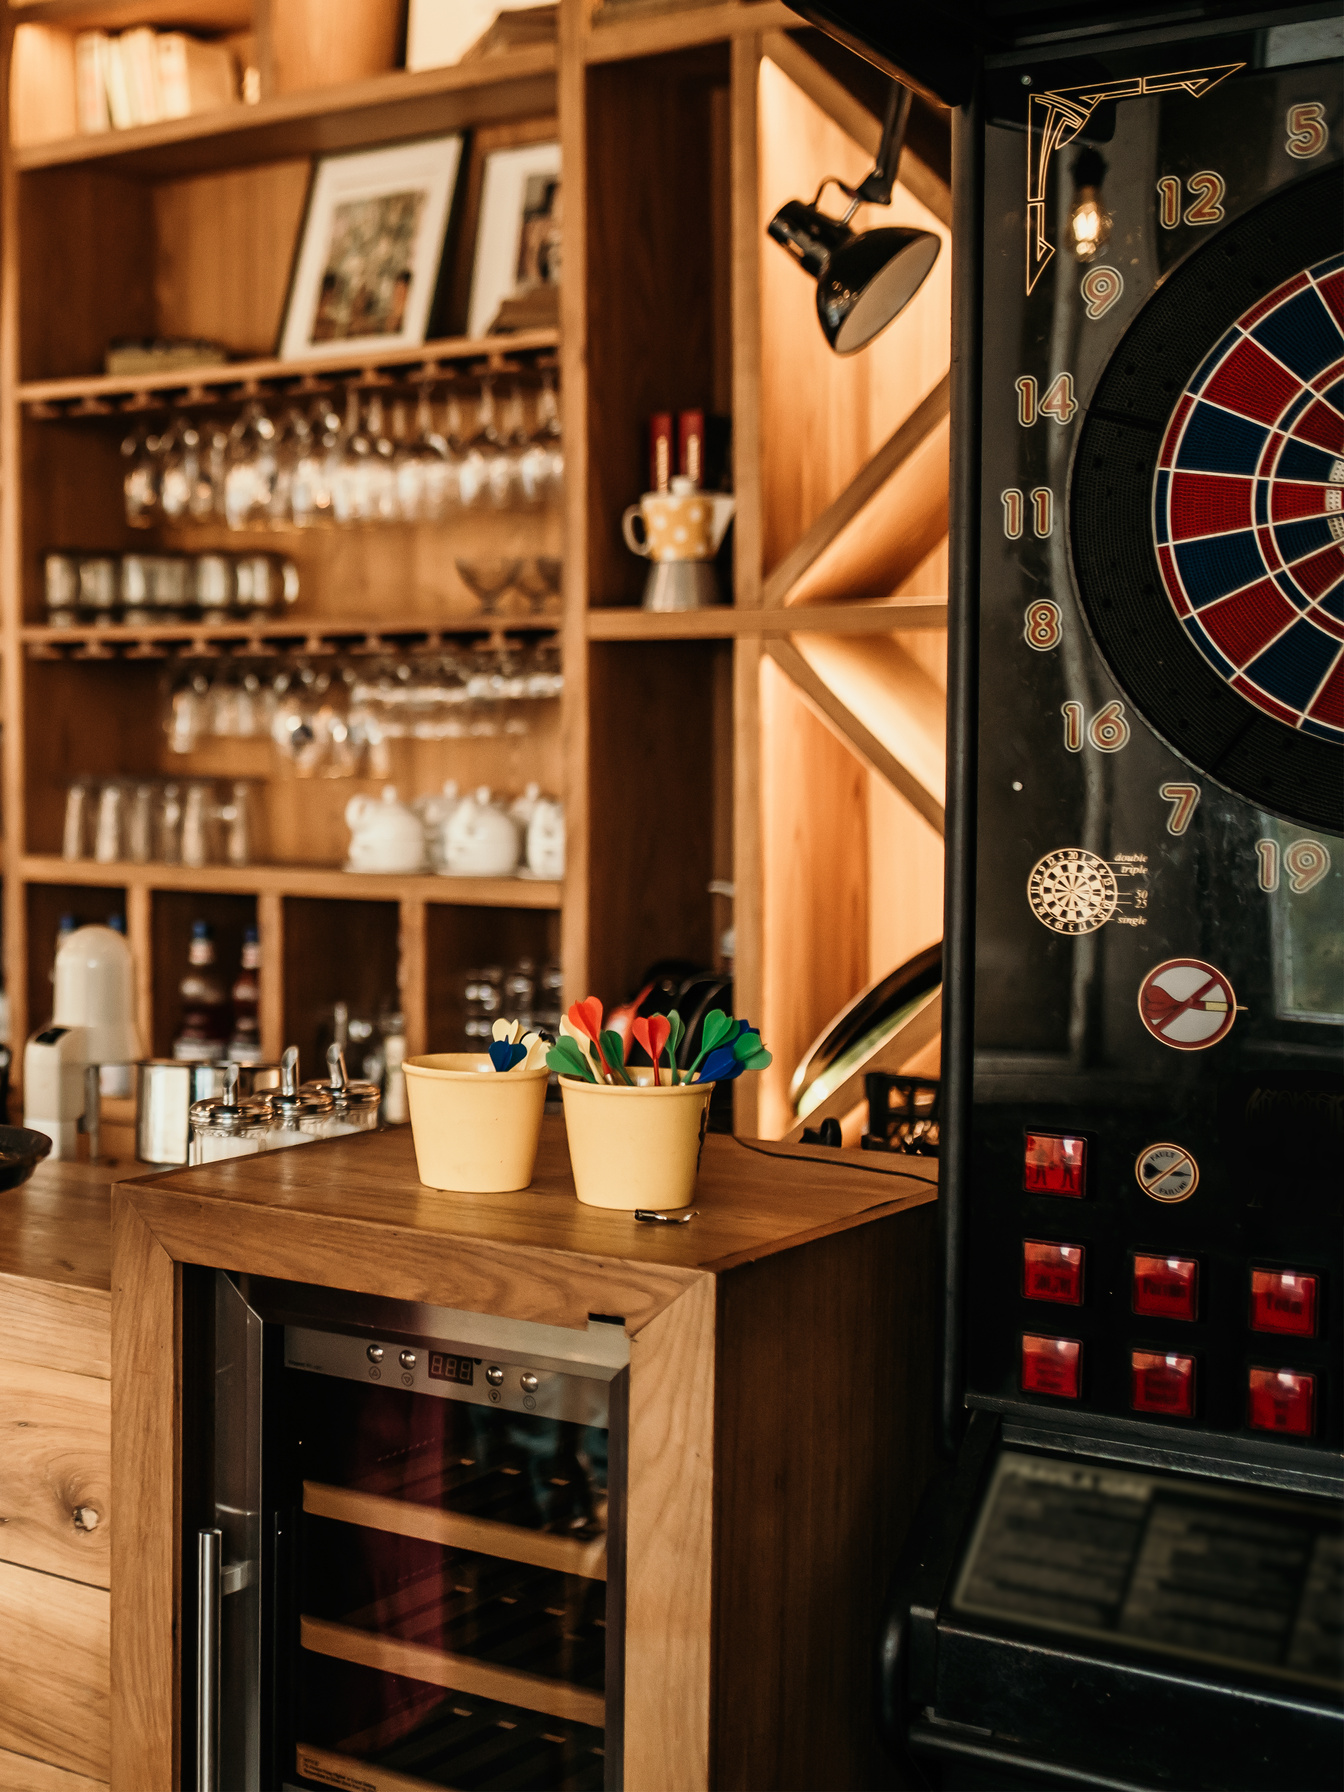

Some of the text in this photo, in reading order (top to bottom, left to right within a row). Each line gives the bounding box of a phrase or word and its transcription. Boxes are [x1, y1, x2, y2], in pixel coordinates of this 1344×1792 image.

[1285, 101, 1329, 159] 5
[1157, 170, 1225, 229] 12
[1081, 265, 1124, 320] 9
[1015, 372, 1078, 427] 14
[1001, 487, 1054, 540] 11
[1024, 599, 1062, 651] 8
[1061, 700, 1131, 753] 16
[1160, 782, 1201, 836] 7
[1046, 856, 1057, 867] 12
[1058, 852, 1065, 861] 5
[1067, 851, 1079, 860] 20
[1114, 853, 1149, 862] double
[1120, 865, 1149, 876] triple
[1256, 838, 1331, 894] 19
[1134, 889, 1149, 899] 50
[1134, 899, 1148, 909] 25
[1117, 915, 1148, 927] single
[1149, 1151, 1175, 1162] FAULT
